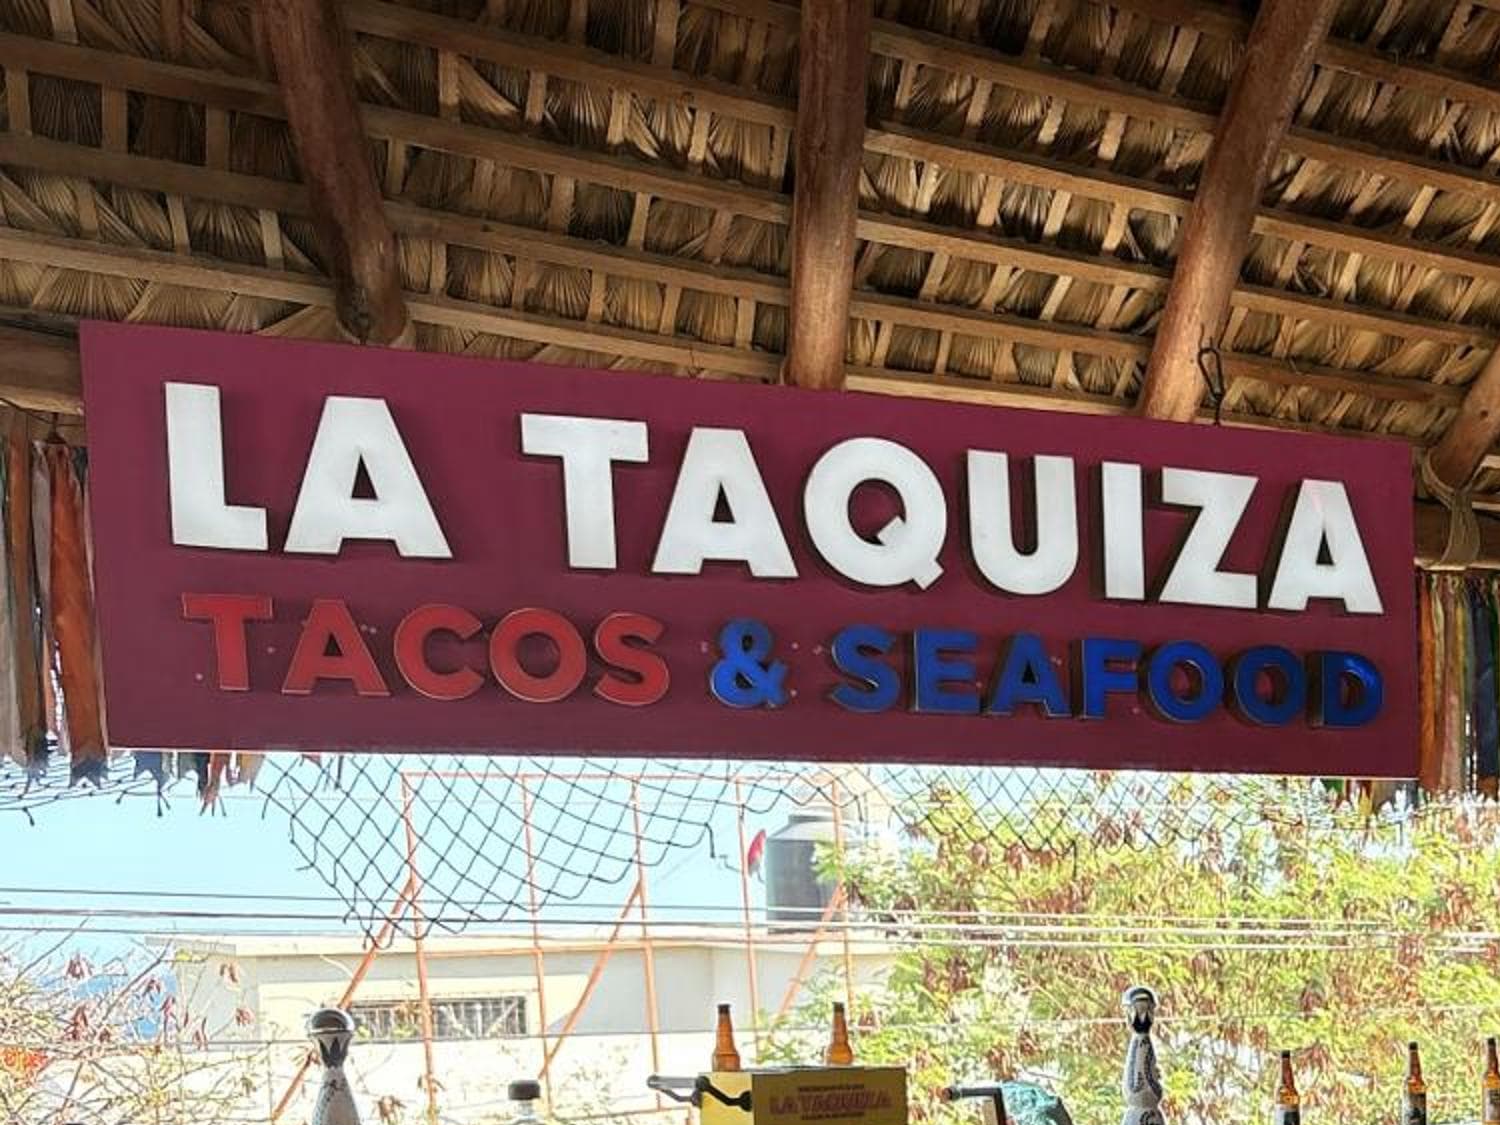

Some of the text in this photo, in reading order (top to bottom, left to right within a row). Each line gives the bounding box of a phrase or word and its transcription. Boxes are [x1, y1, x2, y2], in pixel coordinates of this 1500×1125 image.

[164, 381, 1385, 615] LA TAQUIZA
[181, 593, 1385, 729] TACOS & SEAFOOD
